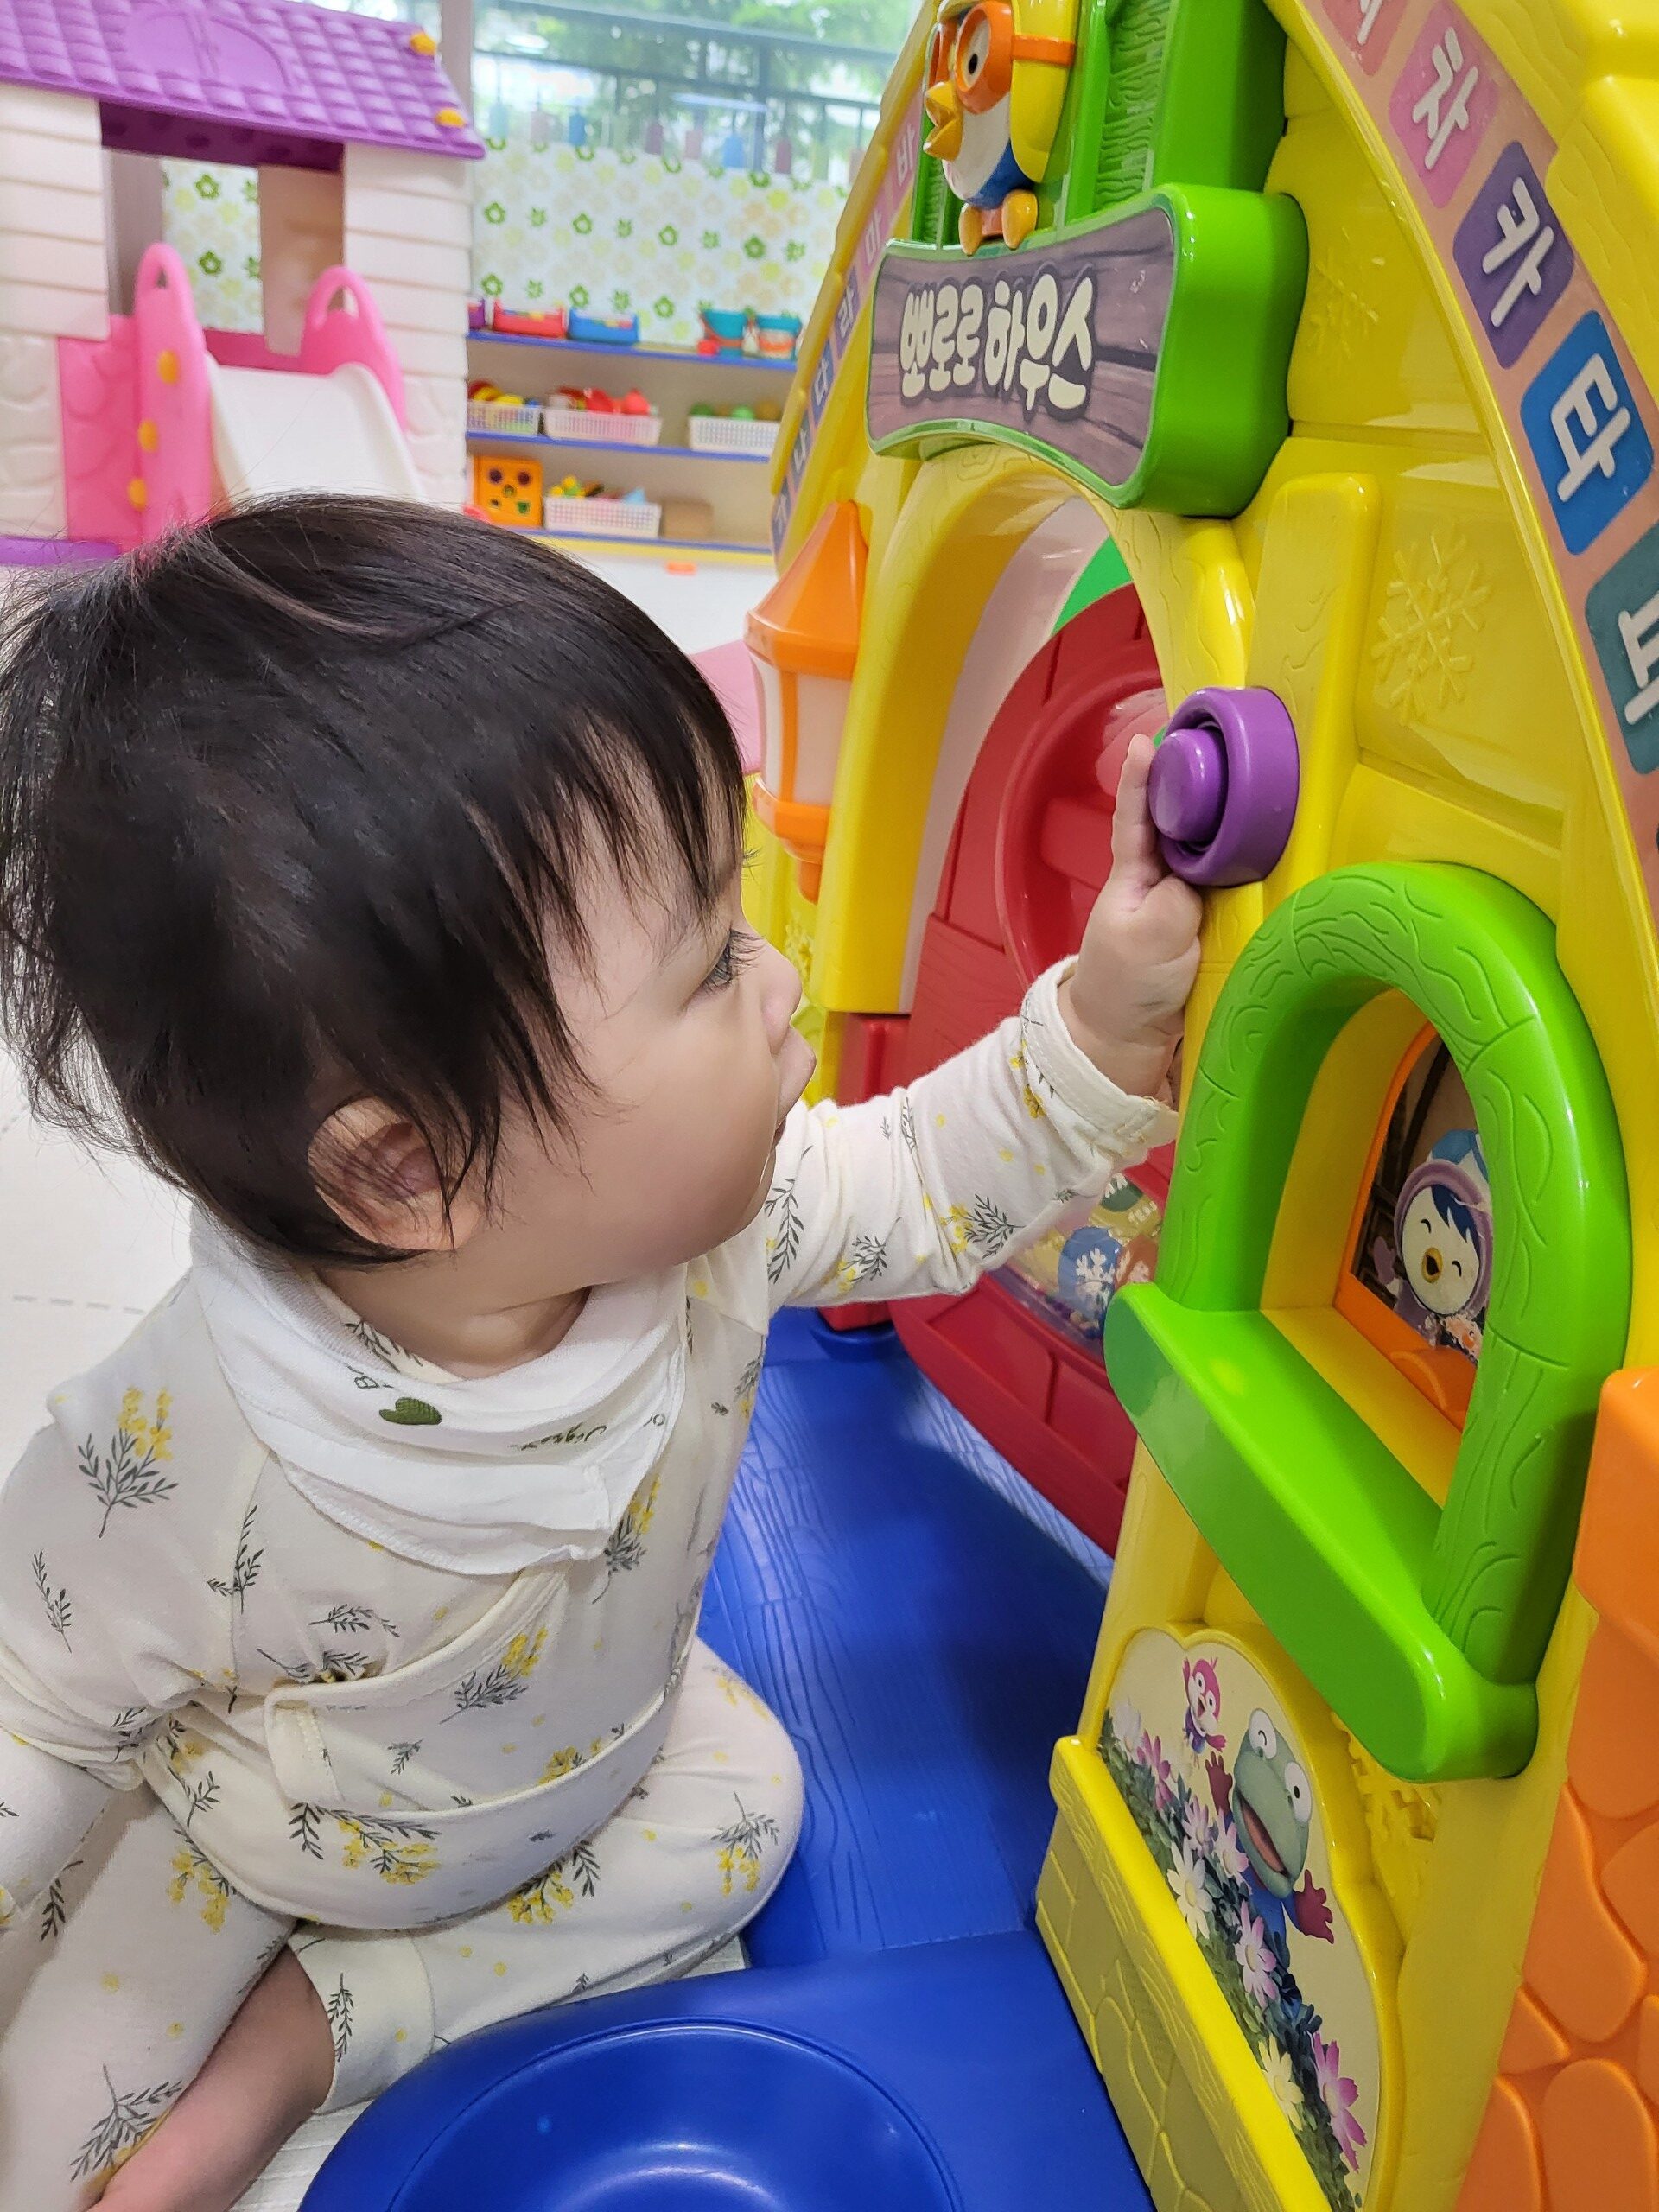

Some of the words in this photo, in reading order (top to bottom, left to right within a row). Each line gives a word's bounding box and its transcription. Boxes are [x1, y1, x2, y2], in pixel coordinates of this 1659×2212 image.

[814, 358, 830, 406] 다
[837, 286, 855, 339] 라
[865, 209, 882, 266] 마
[896, 122, 916, 187] 바
[1412, 27, 1479, 170] 차
[1481, 176, 1554, 327] 카
[1551, 353, 1631, 502] 타
